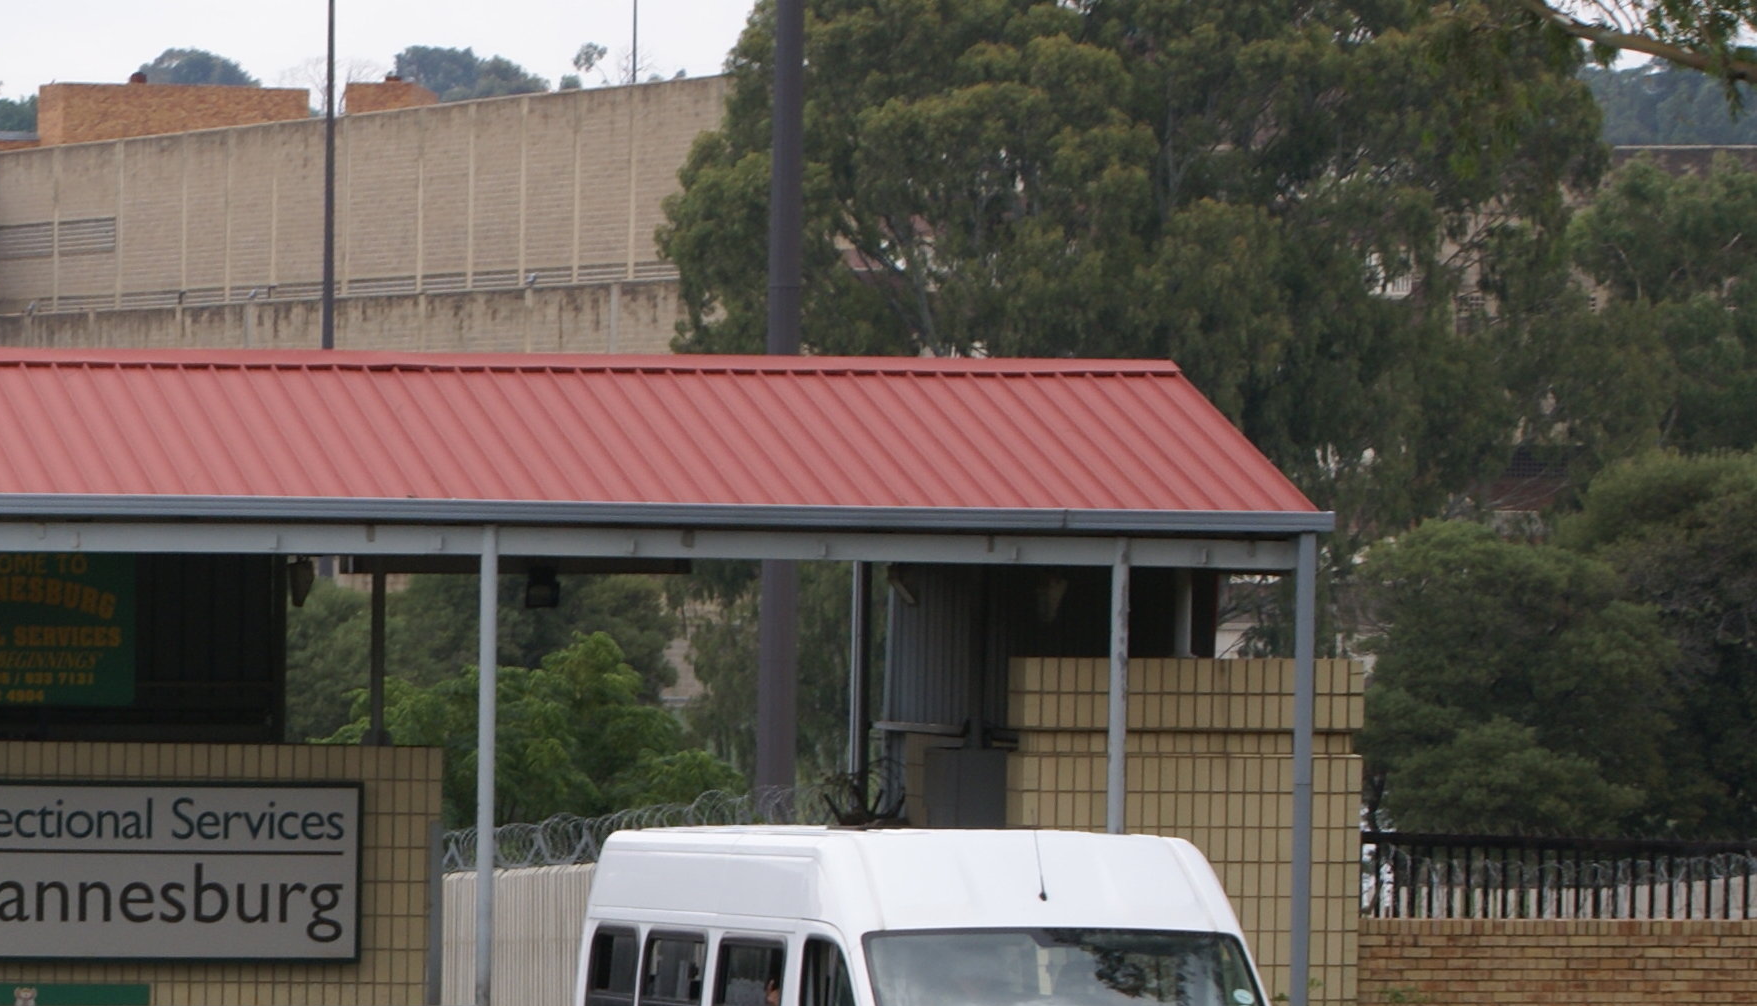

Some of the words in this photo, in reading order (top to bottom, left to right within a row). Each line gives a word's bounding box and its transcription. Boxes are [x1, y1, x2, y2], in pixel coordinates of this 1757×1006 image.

[57, 553, 88, 575] TO
[12, 625, 123, 648] SERVICES
[170, 797, 344, 842] Services
